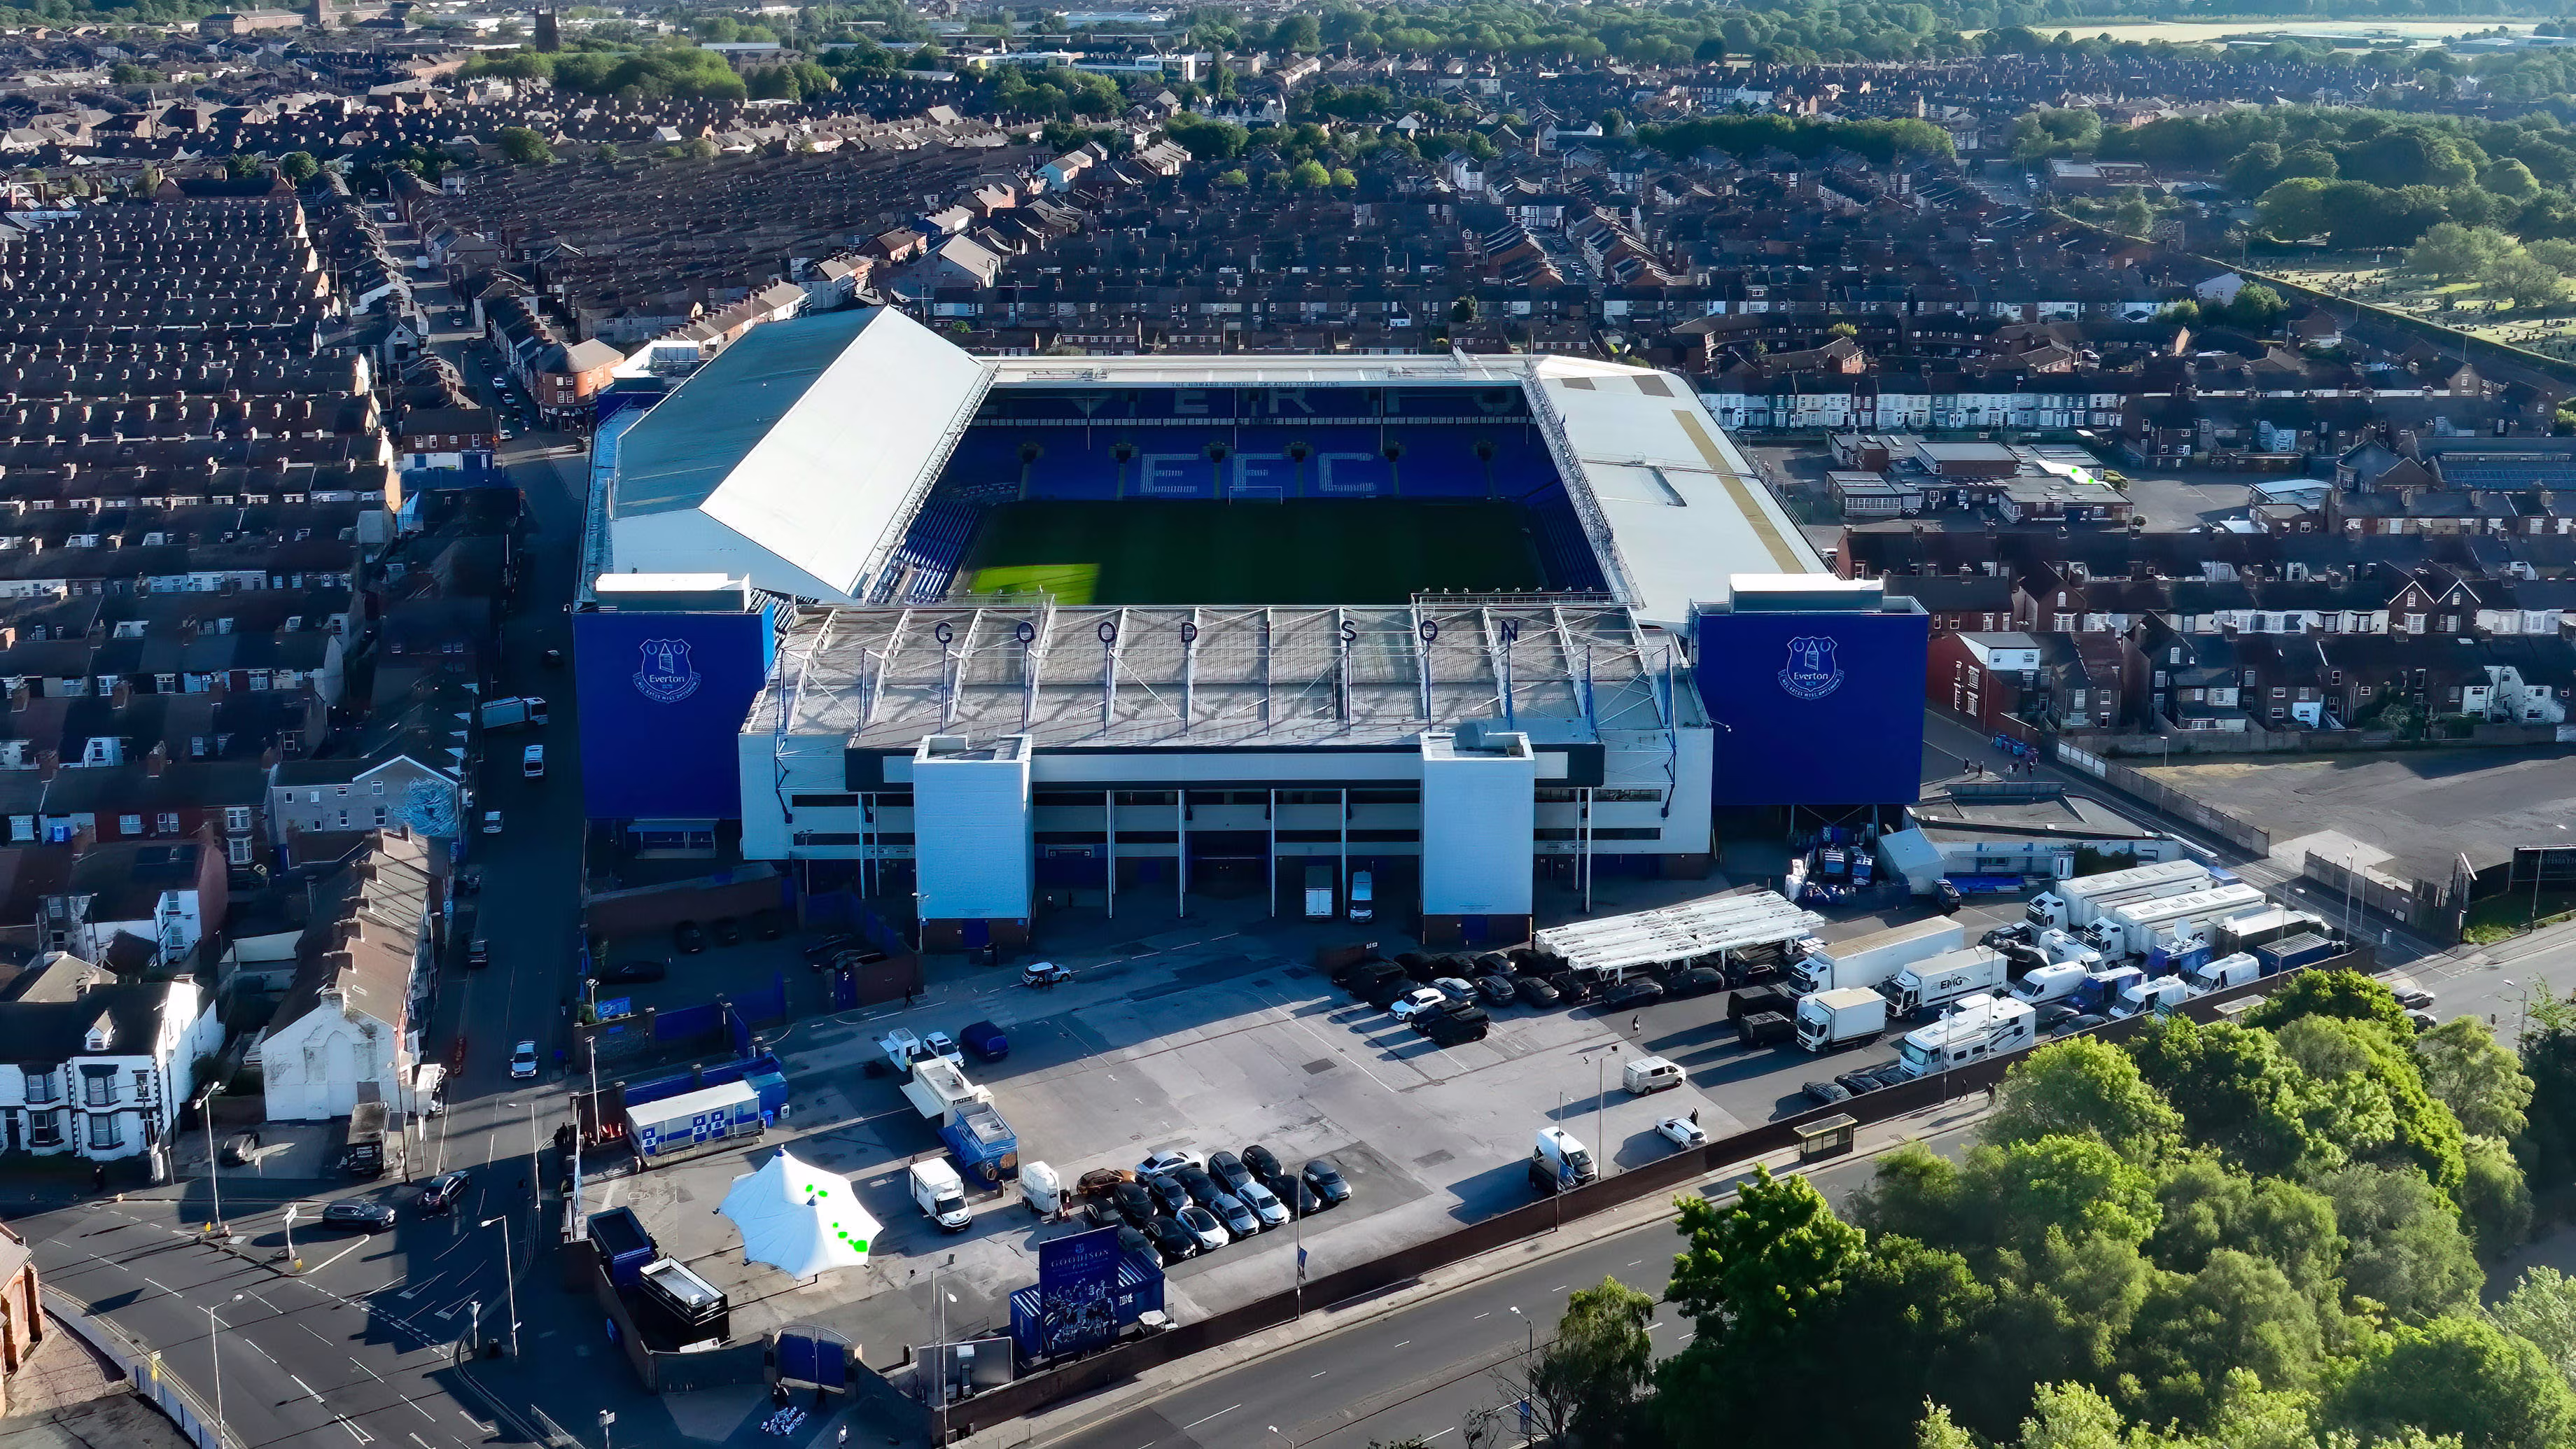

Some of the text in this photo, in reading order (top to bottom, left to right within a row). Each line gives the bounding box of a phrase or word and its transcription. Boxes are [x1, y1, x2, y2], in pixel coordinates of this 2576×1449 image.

[1140, 453, 1376, 493] EFC
[935, 620, 1518, 644] GOODISON
[650, 674, 685, 683] Everton
[1793, 672, 1828, 680] Everton
[1051, 1249, 1109, 1268] GOODISON
